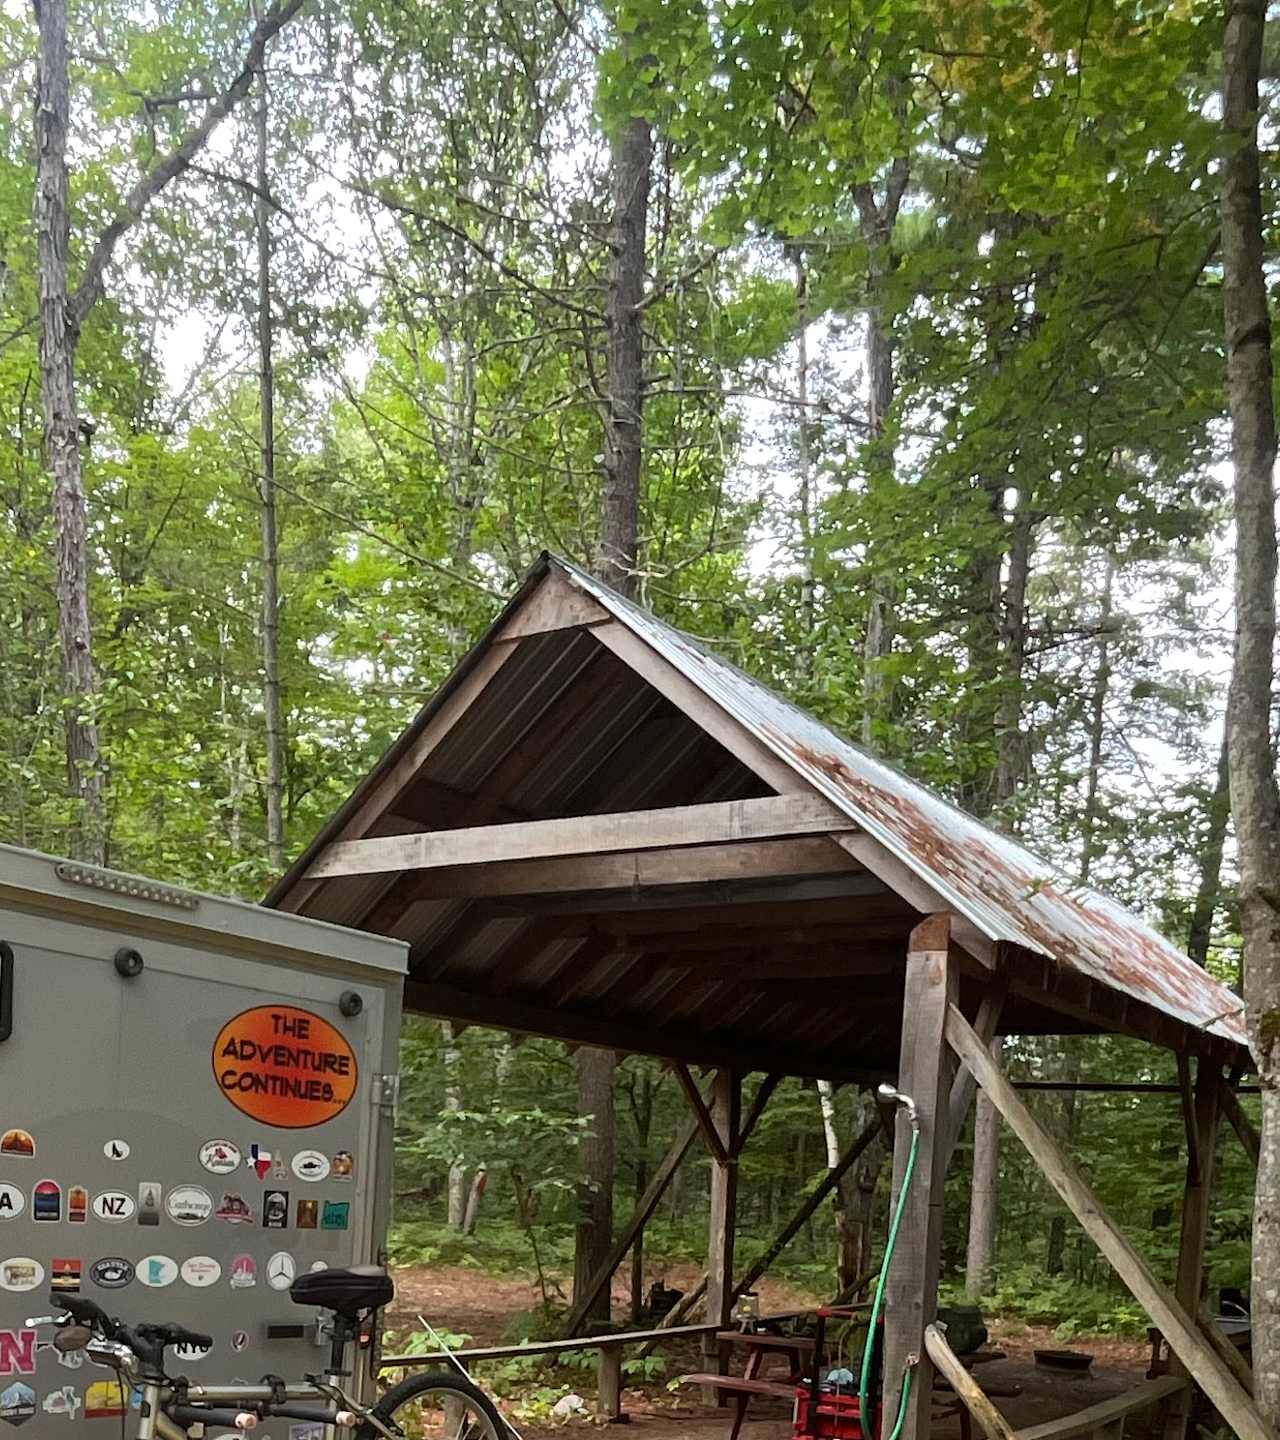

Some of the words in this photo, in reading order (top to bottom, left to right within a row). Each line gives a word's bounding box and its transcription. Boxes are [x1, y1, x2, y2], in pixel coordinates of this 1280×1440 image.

[271, 1014, 310, 1040] THE
[222, 1037, 350, 1076] ADVENTURE
[102, 1197, 126, 1215] NZ
